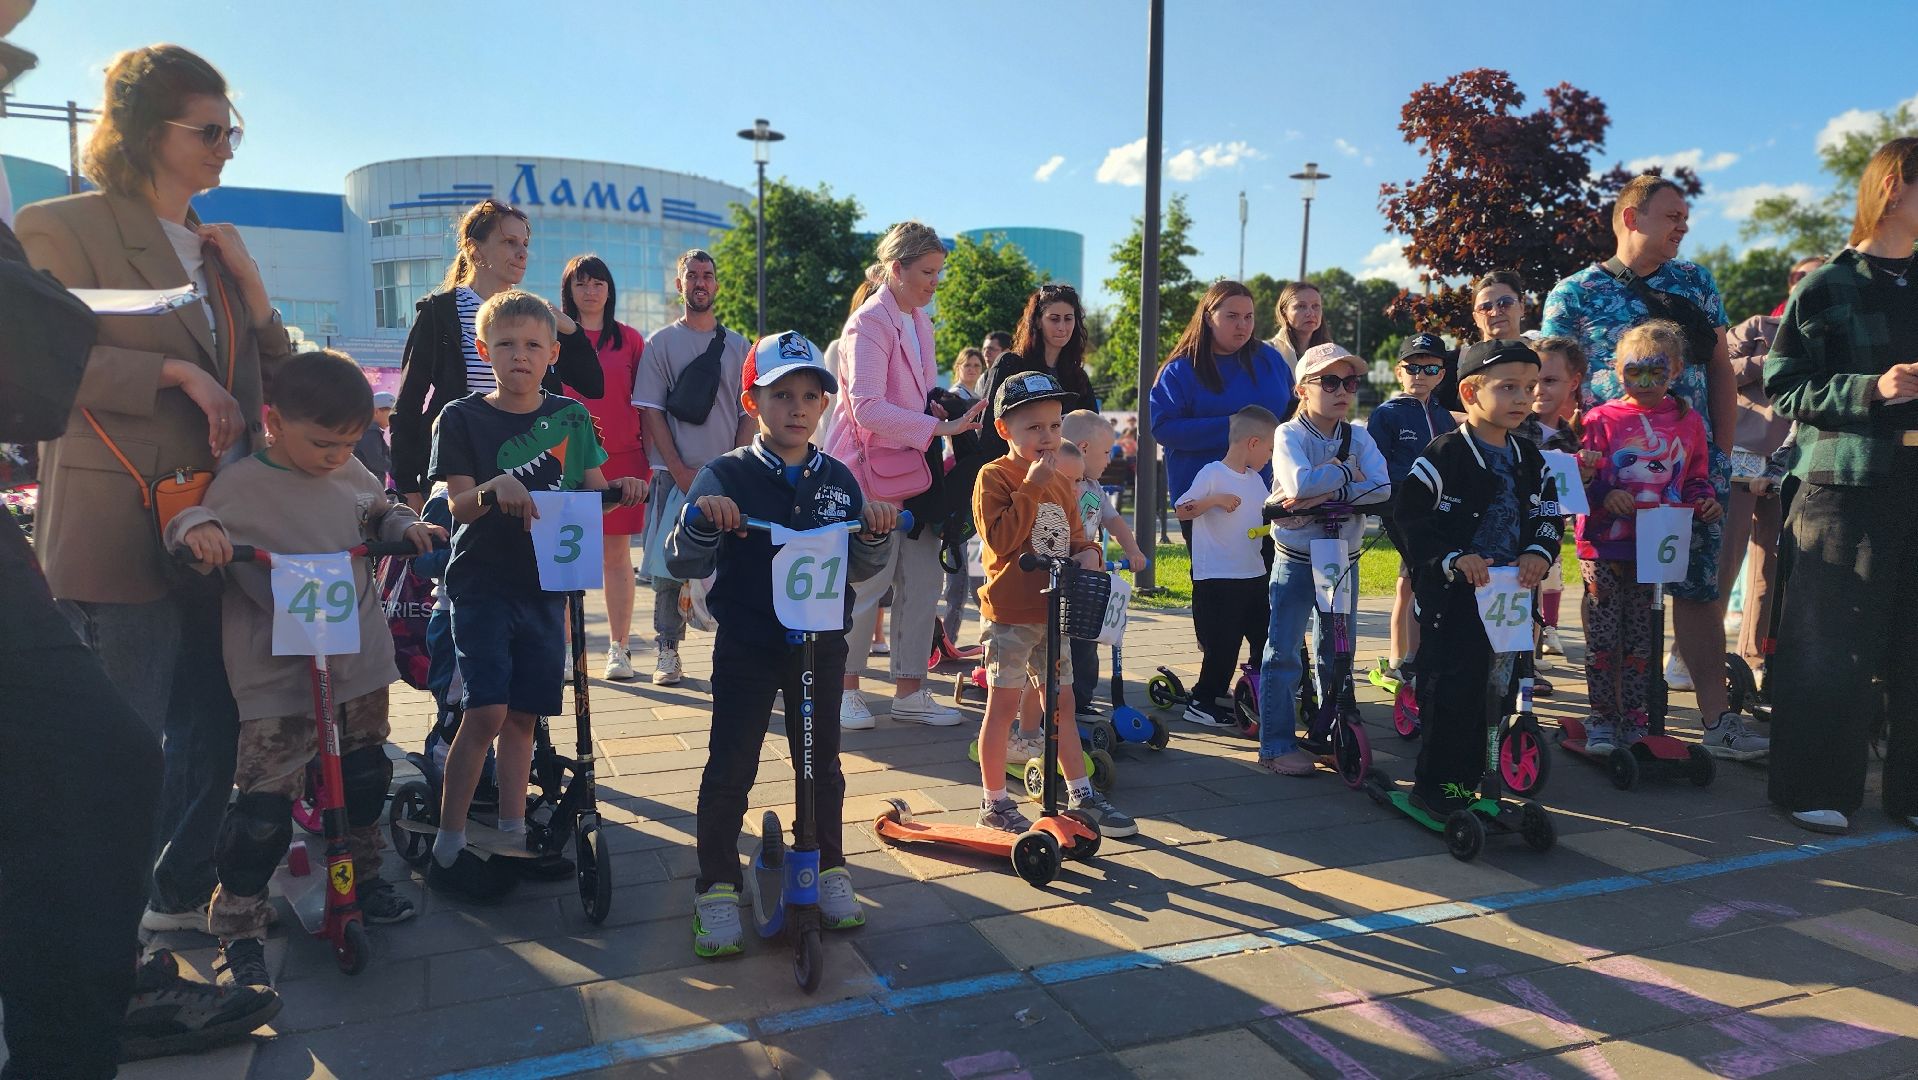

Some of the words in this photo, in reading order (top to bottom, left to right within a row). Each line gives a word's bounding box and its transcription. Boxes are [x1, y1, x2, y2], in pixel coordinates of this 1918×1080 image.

[510, 163, 651, 213] Лама
[554, 524, 583, 563] 3
[1657, 534, 1677, 564] 6
[785, 555, 841, 601] 61
[287, 580, 357, 623] 49
[1103, 591, 1126, 629] 63
[1484, 591, 1531, 627] 45
[801, 670, 814, 780] GLOBBER
